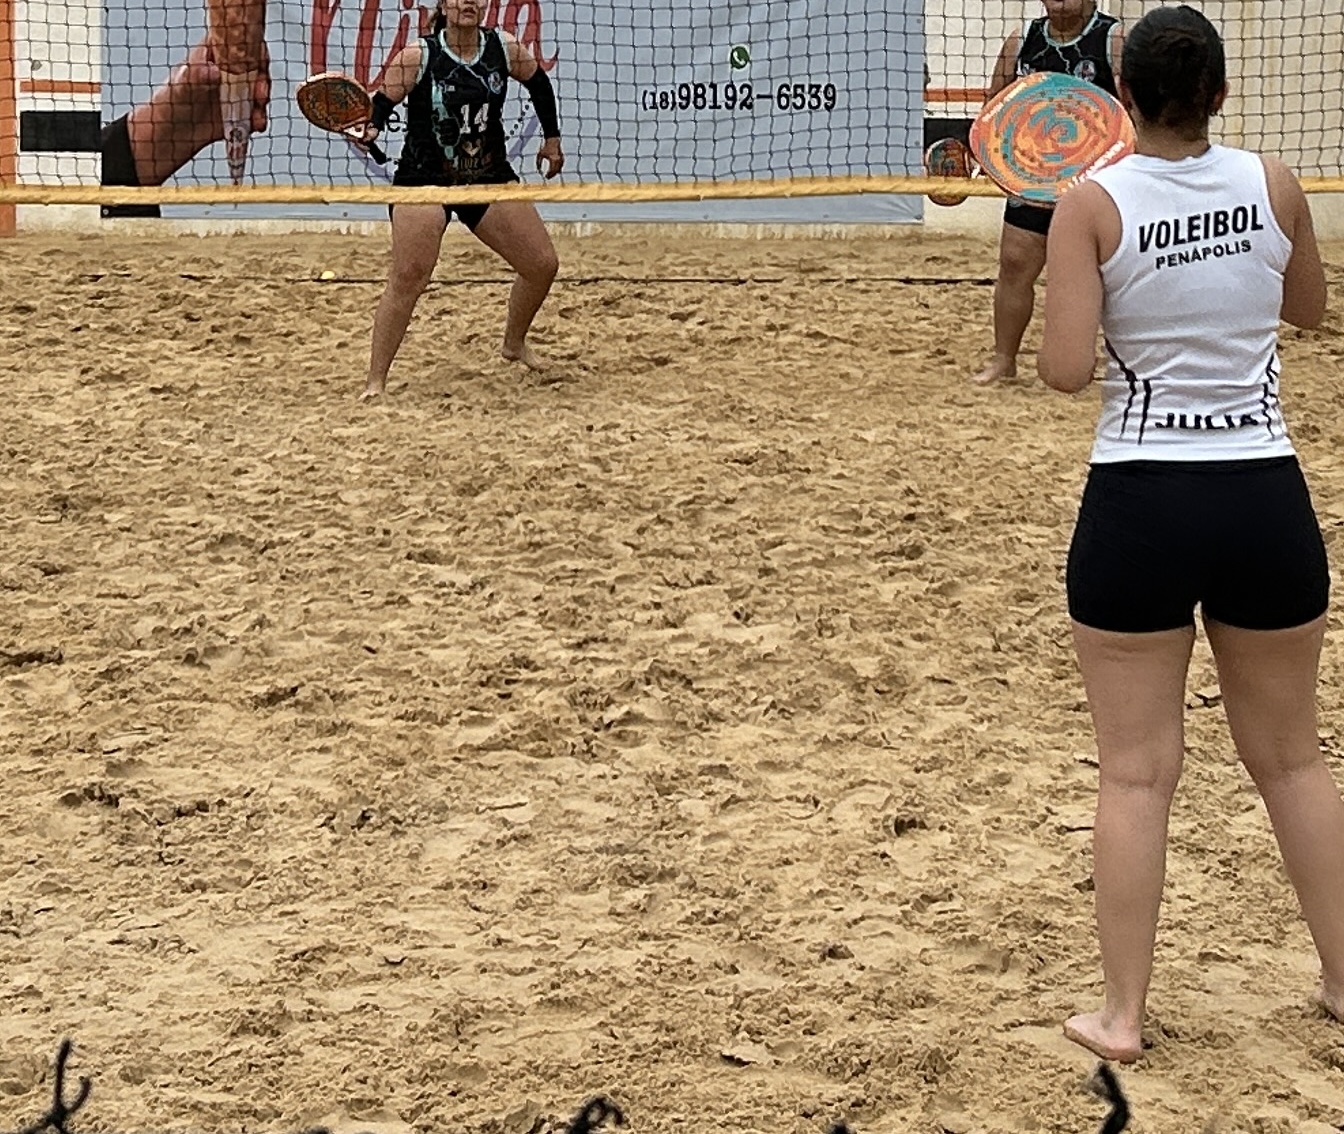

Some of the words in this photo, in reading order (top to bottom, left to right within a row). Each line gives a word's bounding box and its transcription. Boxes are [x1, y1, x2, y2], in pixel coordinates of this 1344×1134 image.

[641, 82, 837, 111] (18)98192-6539
[460, 102, 489, 134] 14
[1138, 204, 1264, 253] VOLEIBOL
[1155, 239, 1252, 270] PENÁPOLIS
[1155, 412, 1258, 430] JULIA
